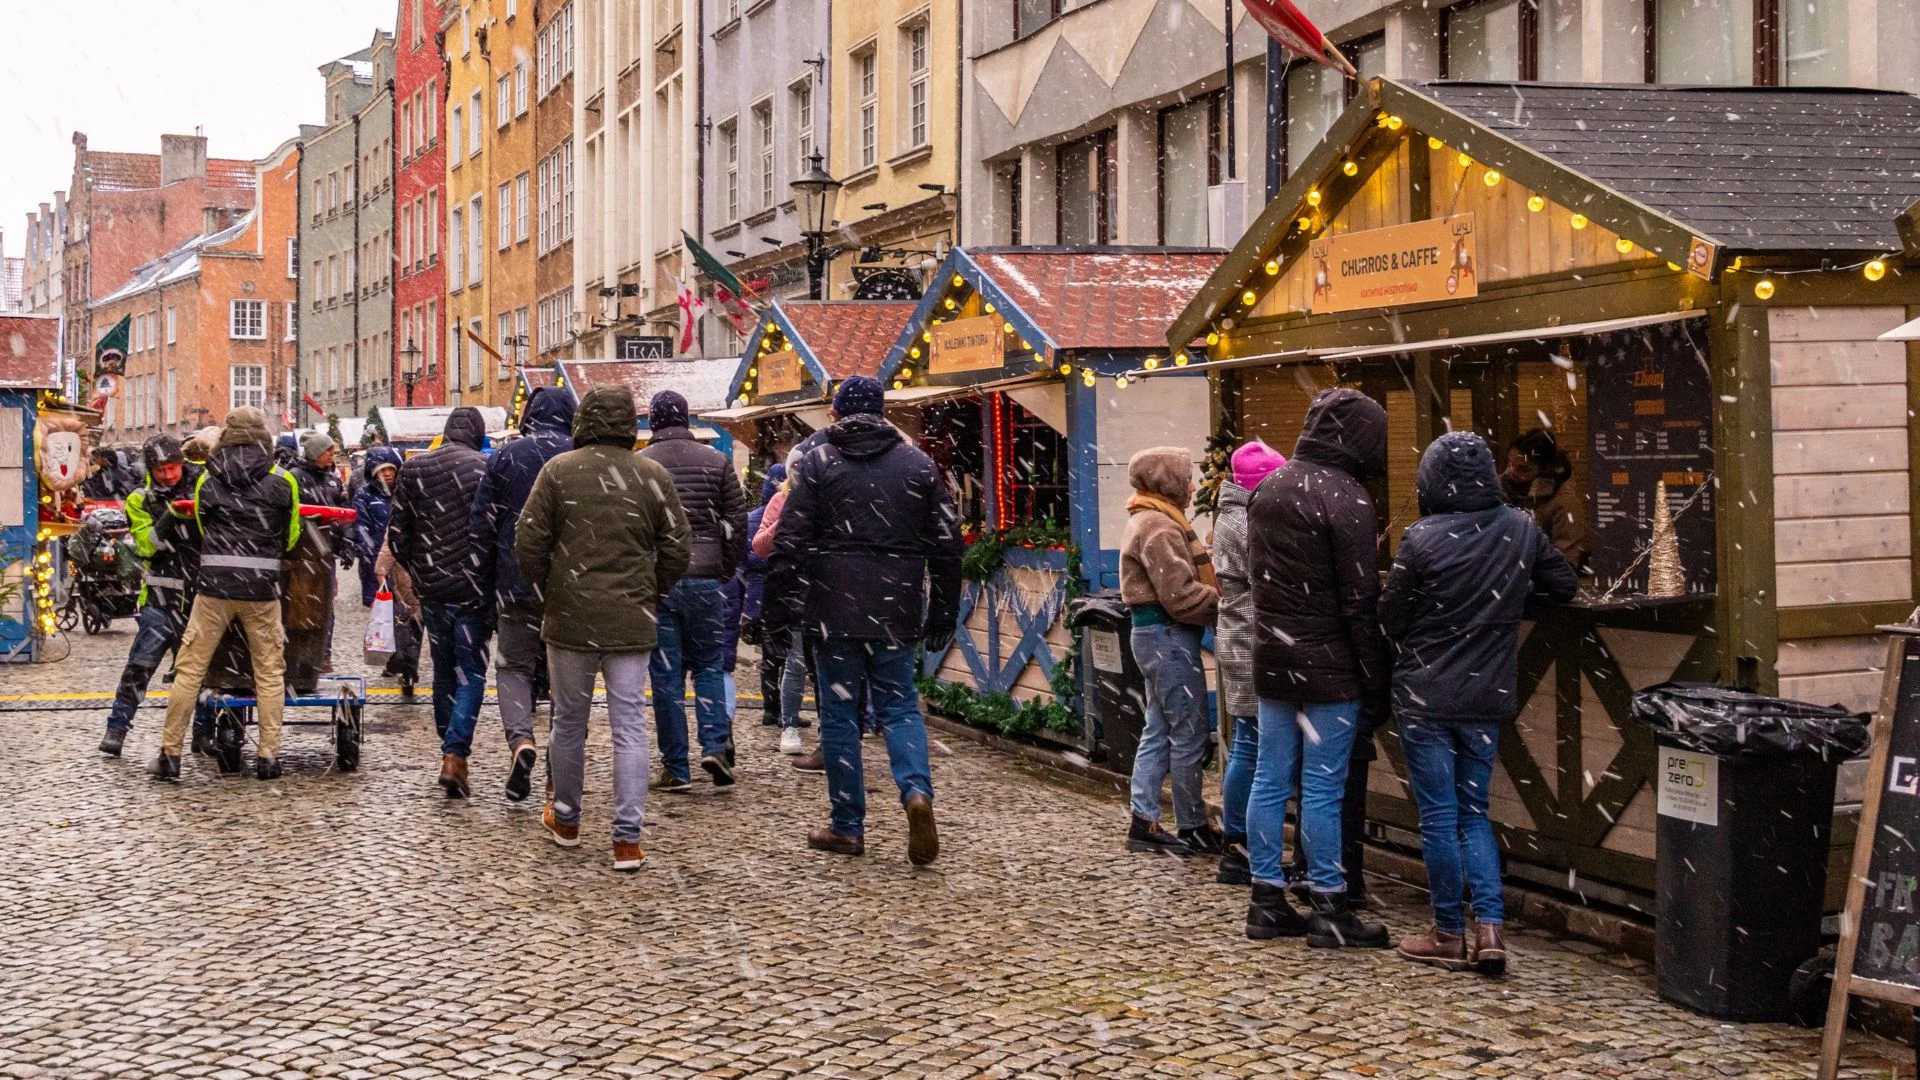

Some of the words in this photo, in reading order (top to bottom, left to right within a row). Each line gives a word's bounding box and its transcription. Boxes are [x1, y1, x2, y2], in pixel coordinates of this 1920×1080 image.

[1341, 254, 1388, 277] CHURROS
[1391, 252, 1399, 270] &
[1401, 246, 1438, 269] CAFFE
[1668, 756, 1686, 770] pre
[1667, 771, 1694, 787] zero
